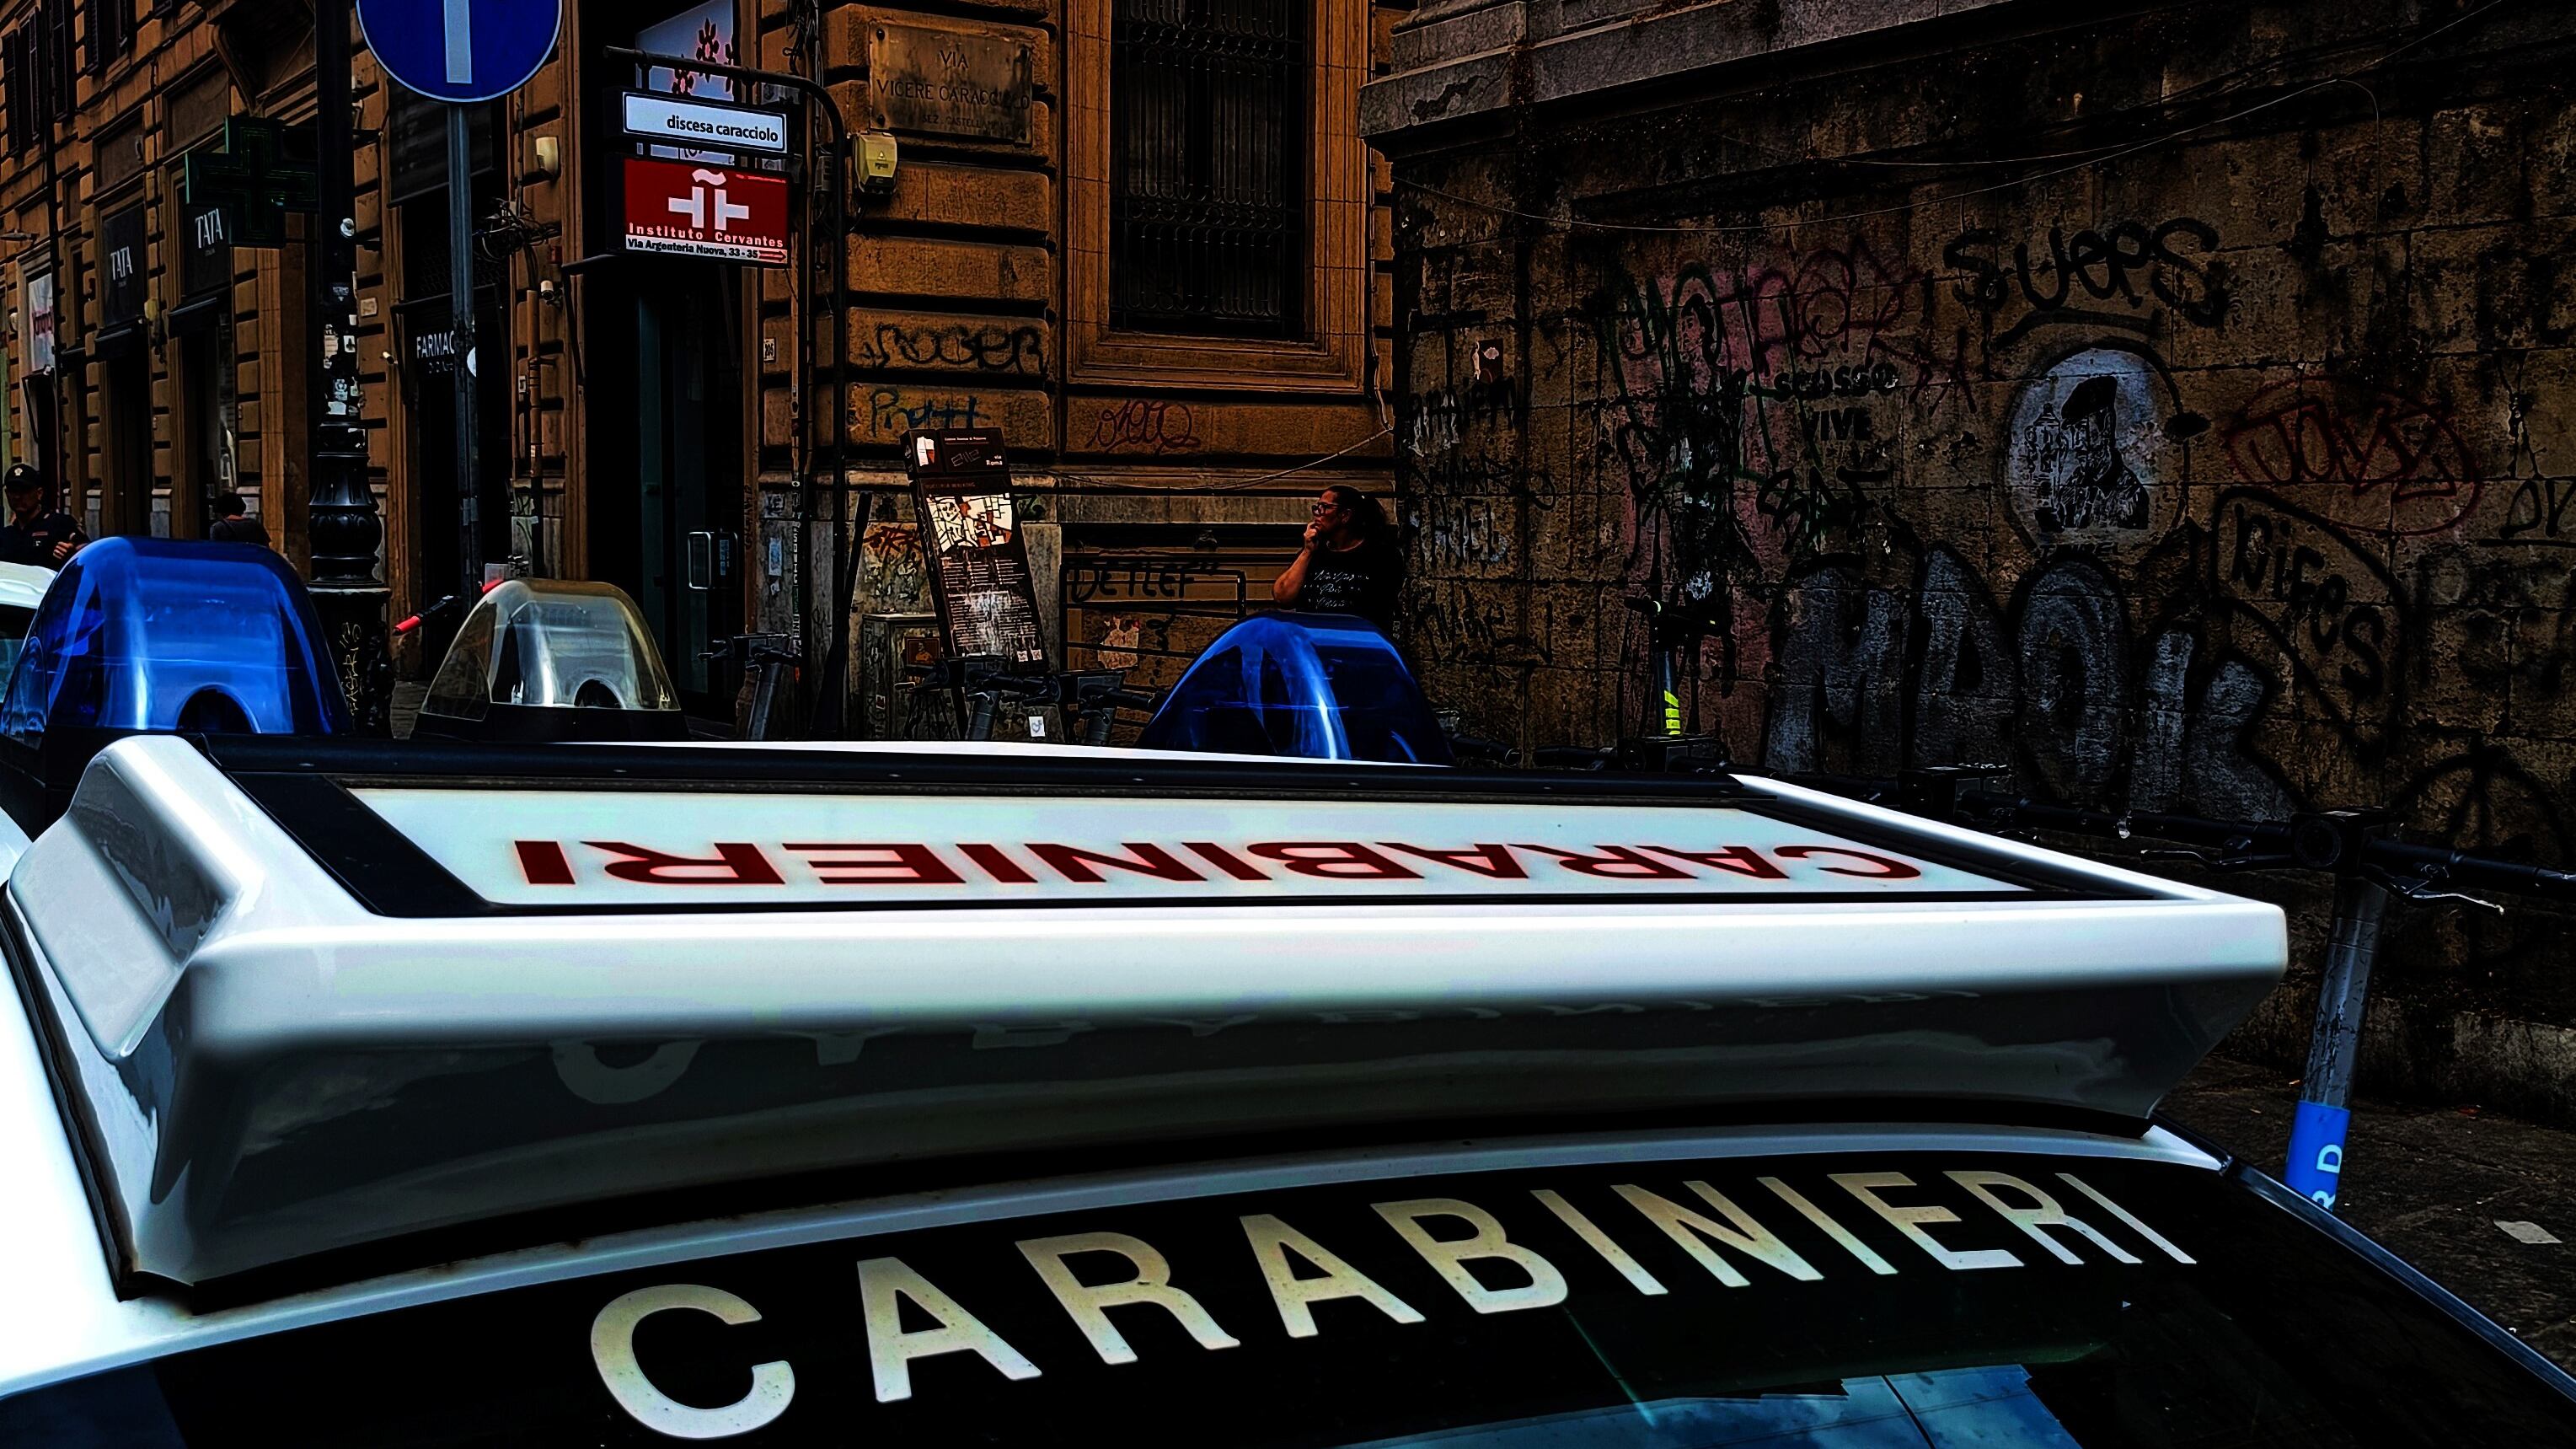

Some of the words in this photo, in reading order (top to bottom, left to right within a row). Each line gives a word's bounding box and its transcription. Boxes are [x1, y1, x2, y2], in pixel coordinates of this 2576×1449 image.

[940, 50, 969, 68] VIA
[939, 86, 1030, 110] CARACCLO
[667, 115, 714, 134] discesa
[715, 124, 779, 142] caracciolo
[194, 207, 224, 250] TATA
[628, 222, 704, 241] Instituto
[714, 230, 785, 249] Cervantes
[627, 238, 644, 249] Via
[645, 239, 694, 253] Argenteria
[110, 245, 134, 282] TATA
[416, 330, 456, 358] FARMAC
[514, 841, 1921, 884] CARABINIERI
[589, 1171, 2198, 1440] CARABINIERI
